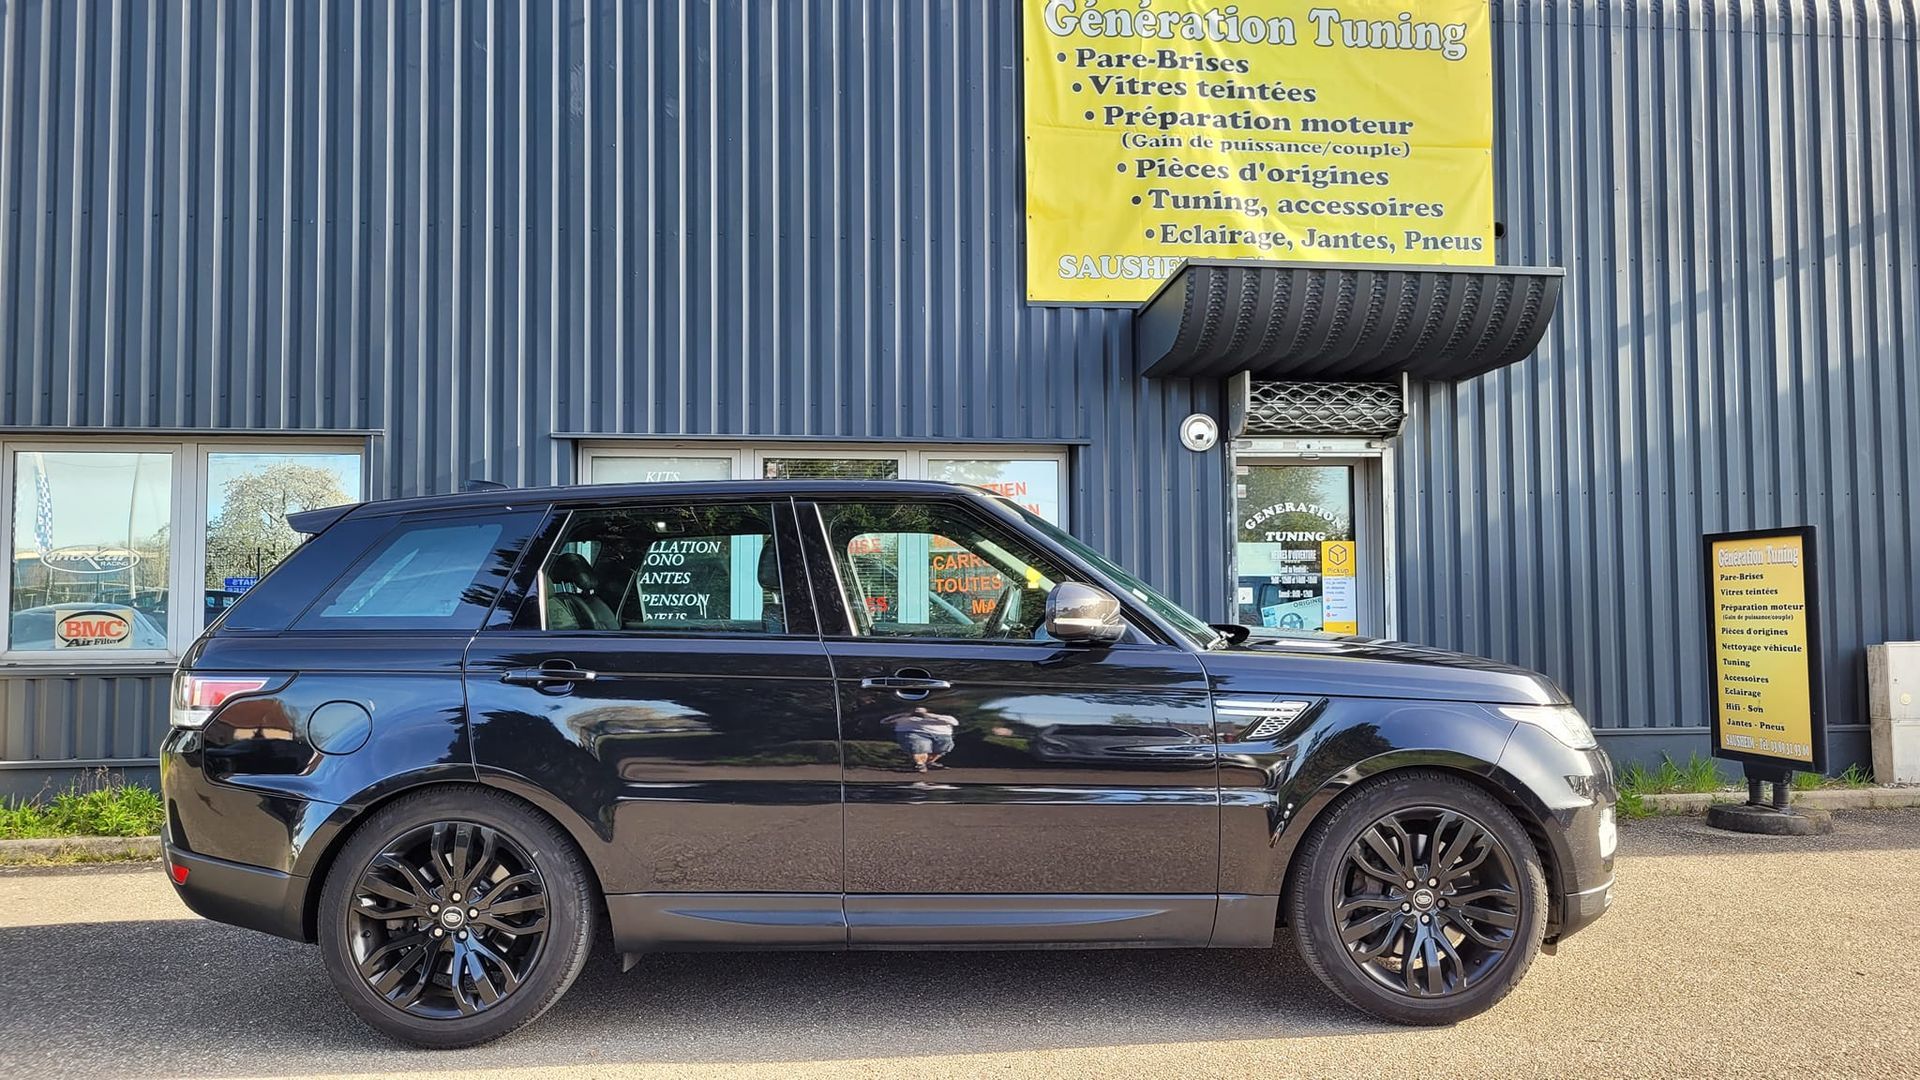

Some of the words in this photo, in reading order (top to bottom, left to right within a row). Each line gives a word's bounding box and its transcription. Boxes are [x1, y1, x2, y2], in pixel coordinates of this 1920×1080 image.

[1044, 0, 1297, 46] Génération
[1308, 8, 1467, 61] Tuning
[1075, 48, 1249, 74] Pare-Brises
[1089, 75, 1187, 96] Vitres
[1197, 79, 1316, 102] teintées
[1104, 105, 1290, 130] Préparation
[1301, 116, 1414, 135] moteur
[1122, 132, 1182, 148] (Gain
[1189, 135, 1213, 148] de
[1221, 138, 1410, 158] puissance/couple)
[1135, 157, 1229, 179] Pièces
[1239, 162, 1389, 189] d'origines
[1148, 188, 1268, 217] Tuning,
[1277, 198, 1444, 217] accessoires
[1160, 224, 1293, 250] Eclairage,
[1301, 228, 1396, 254] Jantes,
[1404, 231, 1482, 251] Pneus
[1058, 255, 1188, 280] SAUSHE
[646, 471, 680, 482] KITS
[1245, 502, 1346, 530] GENERATION
[1265, 531, 1326, 542] TUNING
[644, 554, 684, 566] ONO
[933, 554, 990, 570] CARR
[1718, 548, 1763, 567] Génération
[1766, 545, 1798, 567] Tuning
[935, 575, 1002, 593] TOUTES
[1720, 588, 1743, 596] Vitres
[1720, 603, 1768, 612] Préparation
[64, 620, 123, 638] BMC
[1721, 627, 1744, 635] Pièces
[65, 638, 93, 648] Air
[94, 637, 118, 646] Filter
[1722, 643, 1761, 652] Nettoyage
[1763, 644, 1802, 652] véhicule
[1723, 658, 1750, 667] Tuning
[1723, 674, 1769, 683] Accessoires
[1724, 687, 1761, 697] Eclairage
[1726, 703, 1740, 711] Hifi
[1747, 705, 1764, 713] Son
[1726, 718, 1752, 728] Jantes
[1759, 721, 1785, 731] Pneus
